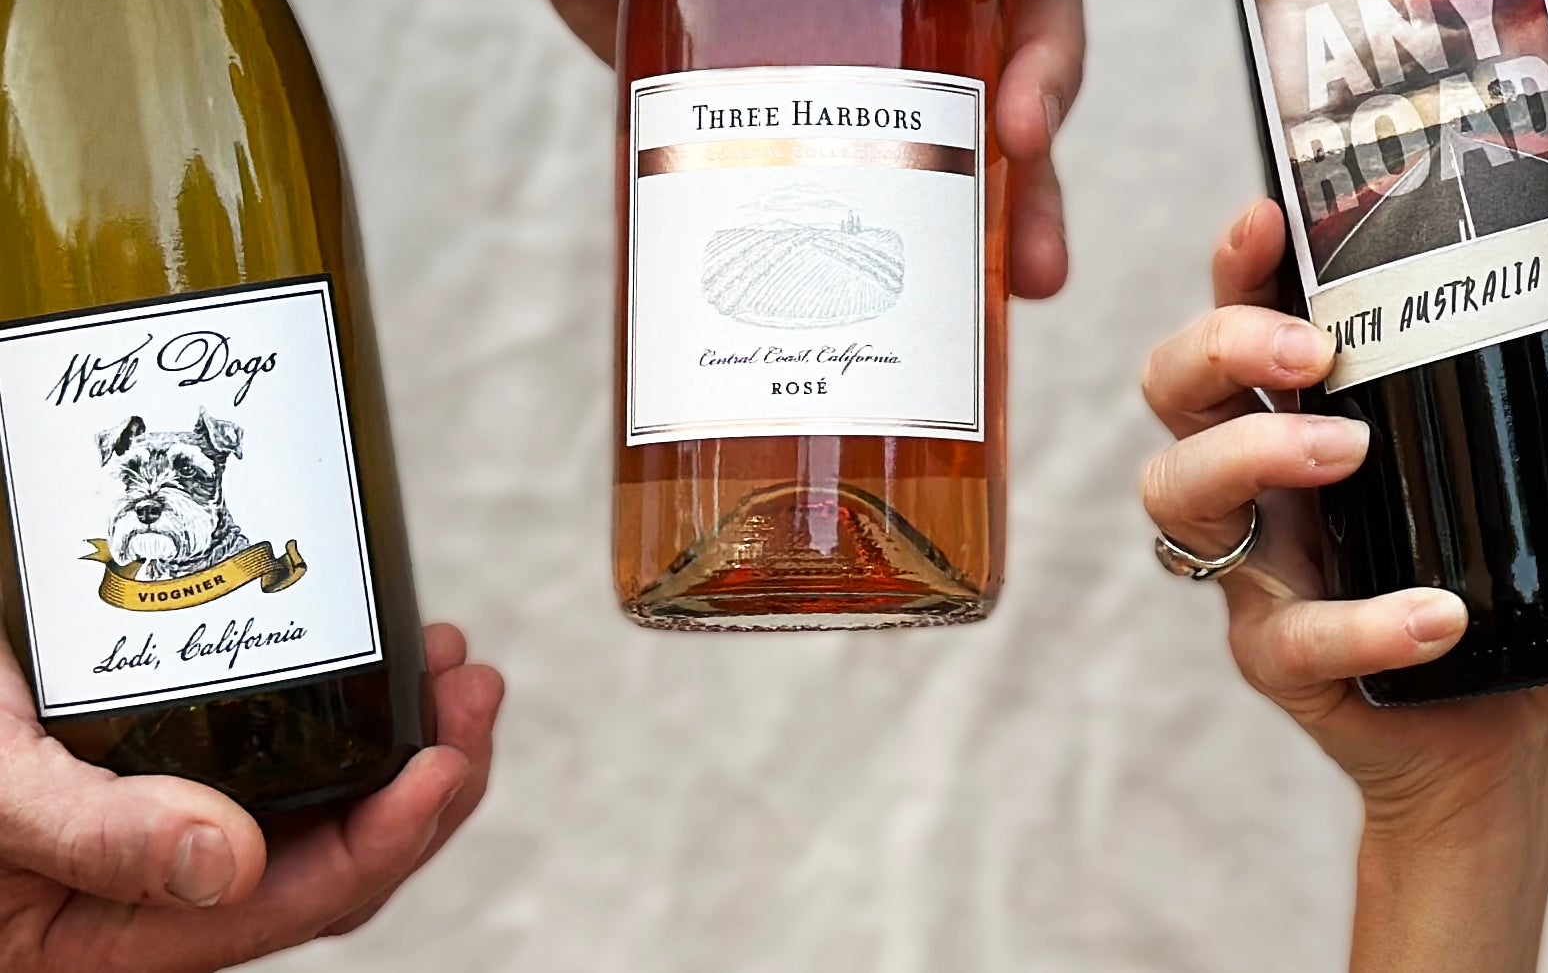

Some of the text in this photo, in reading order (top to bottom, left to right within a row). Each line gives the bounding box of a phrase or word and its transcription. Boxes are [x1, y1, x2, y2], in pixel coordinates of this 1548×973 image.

[692, 100, 922, 131] THREE HARBORS
[1328, 256, 1541, 354] OUTH AUSTRALIA
[46, 331, 278, 407] Wall Dogs
[699, 347, 762, 367] Central
[816, 343, 901, 376] California
[771, 377, 828, 395] ROSÉ
[138, 574, 226, 604] VIOGNIER
[93, 618, 307, 674] Lodi, California
